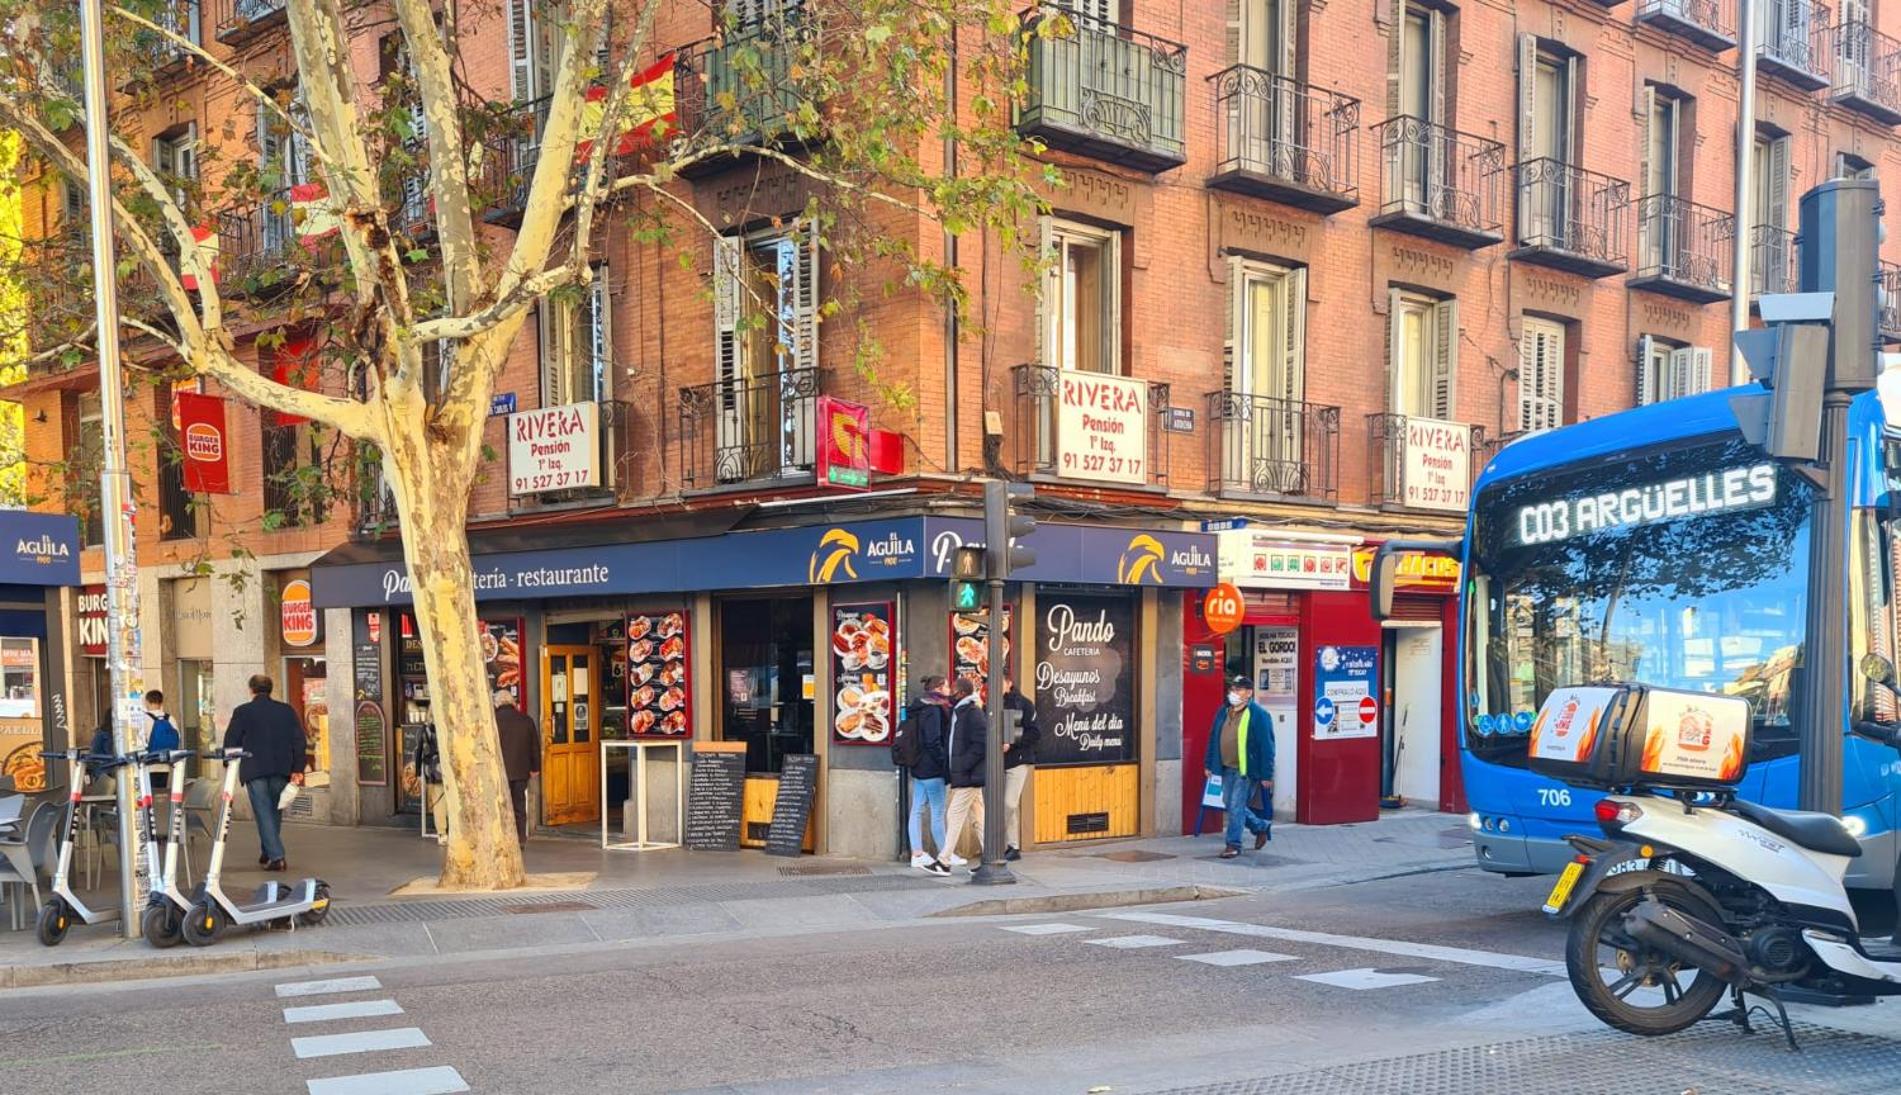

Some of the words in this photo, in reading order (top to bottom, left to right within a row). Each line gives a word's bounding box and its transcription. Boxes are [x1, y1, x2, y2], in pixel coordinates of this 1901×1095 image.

[1063, 380, 1142, 414] RIVERA
[517, 408, 584, 442] RIVERA
[1082, 414, 1124, 434] Pensión
[188, 433, 219, 443] BURGER
[189, 443, 219, 454] KING
[1409, 424, 1465, 452] RIVERA
[1063, 452, 1078, 469] 91
[1083, 455, 1105, 471] 527
[1108, 458, 1123, 473] 37
[1128, 459, 1141, 475] 17
[515, 478, 528, 490] 91
[532, 475, 552, 489] 527
[557, 472, 570, 486] 37
[575, 469, 588, 483] 17
[1408, 486, 1419, 499] 91
[1423, 488, 1438, 501] 527
[1455, 491, 1464, 504] 17
[1575, 465, 1777, 532] ARGÜELLES
[517, 564, 609, 588] restaurante
[78, 594, 108, 612] BURG
[1209, 589, 1236, 615] ria
[79, 617, 109, 645] KIN
[283, 614, 313, 631] KING
[1047, 604, 1115, 651] Pando
[1258, 641, 1267, 654] EL
[1036, 661, 1100, 690] Desayunos
[1054, 686, 1096, 707] Breakfast
[1054, 712, 1089, 740] Menú
[1091, 713, 1107, 730] del
[1080, 733, 1103, 751] Daily
[1537, 789, 1571, 806] 706
